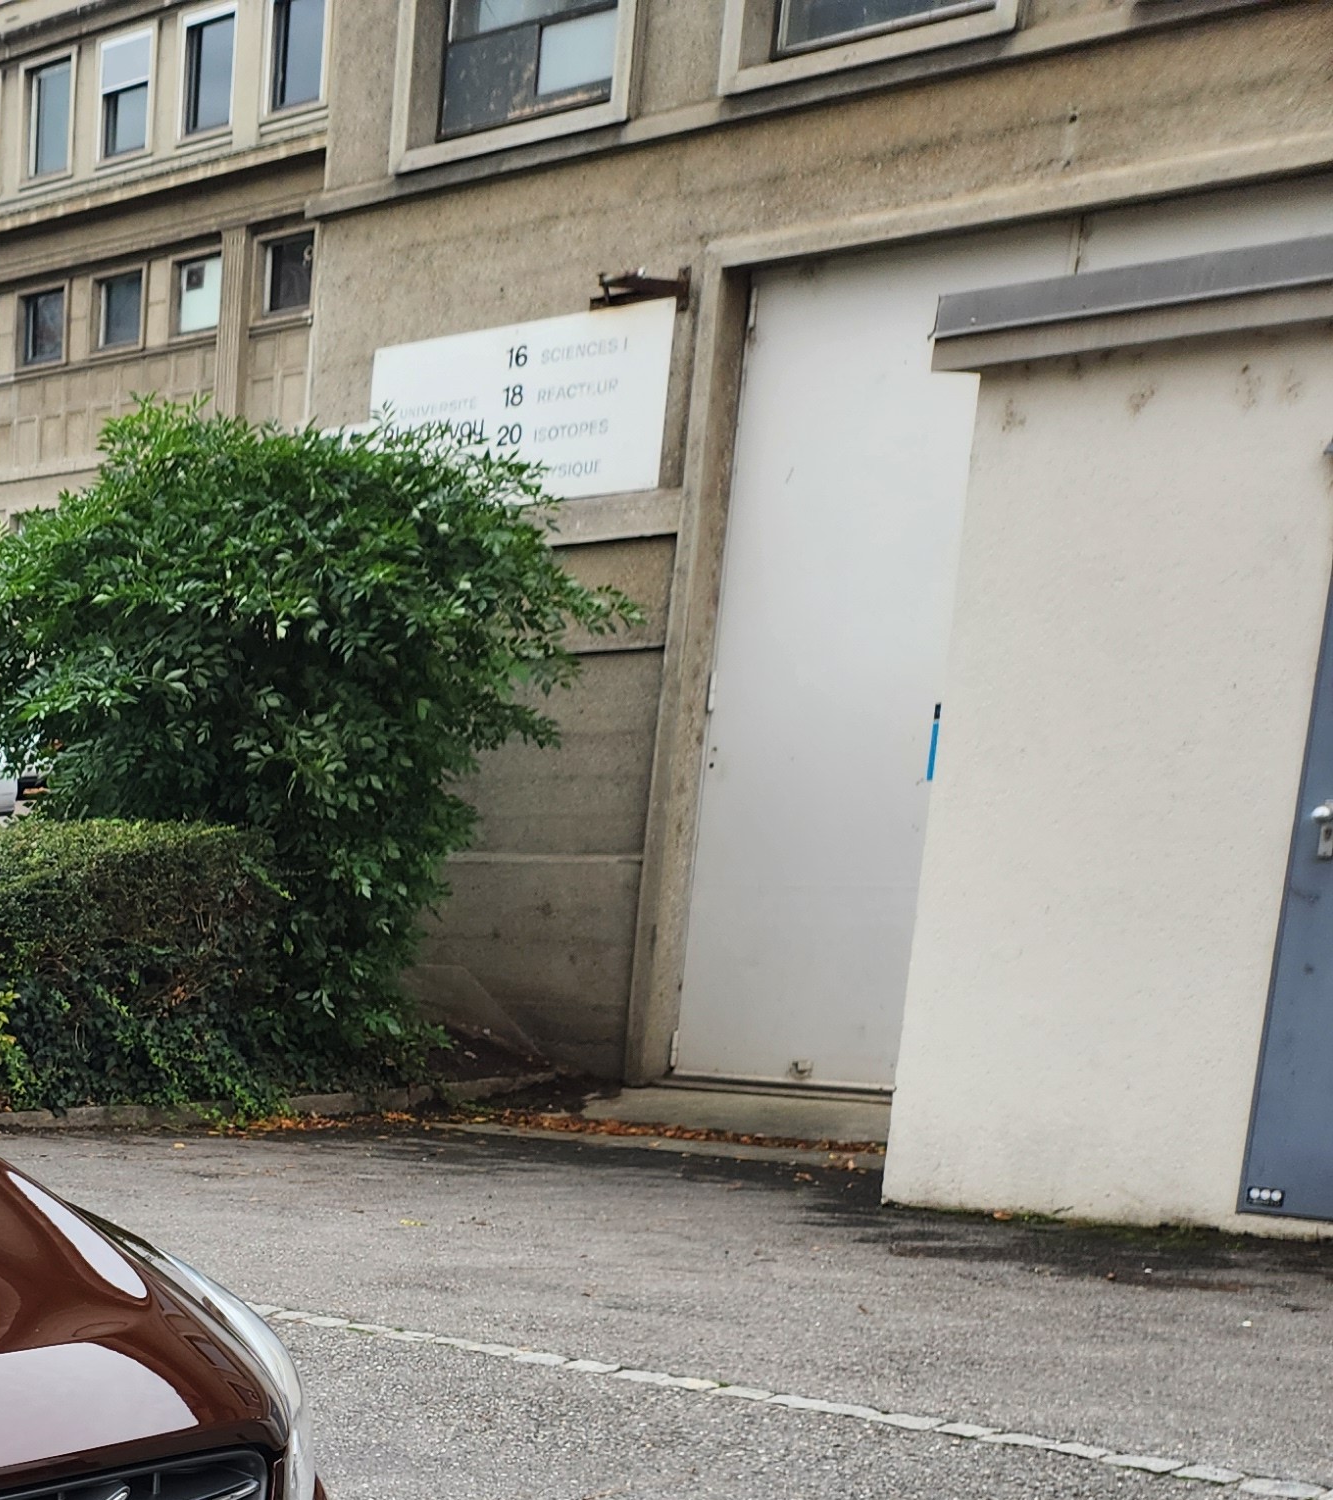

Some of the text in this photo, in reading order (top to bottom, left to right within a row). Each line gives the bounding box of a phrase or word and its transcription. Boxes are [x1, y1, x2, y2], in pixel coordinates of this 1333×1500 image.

[507, 345, 528, 370] 16
[540, 338, 619, 365] SCIENCES
[502, 384, 524, 408] 18
[496, 417, 609, 448] 20 ISOTOPES
